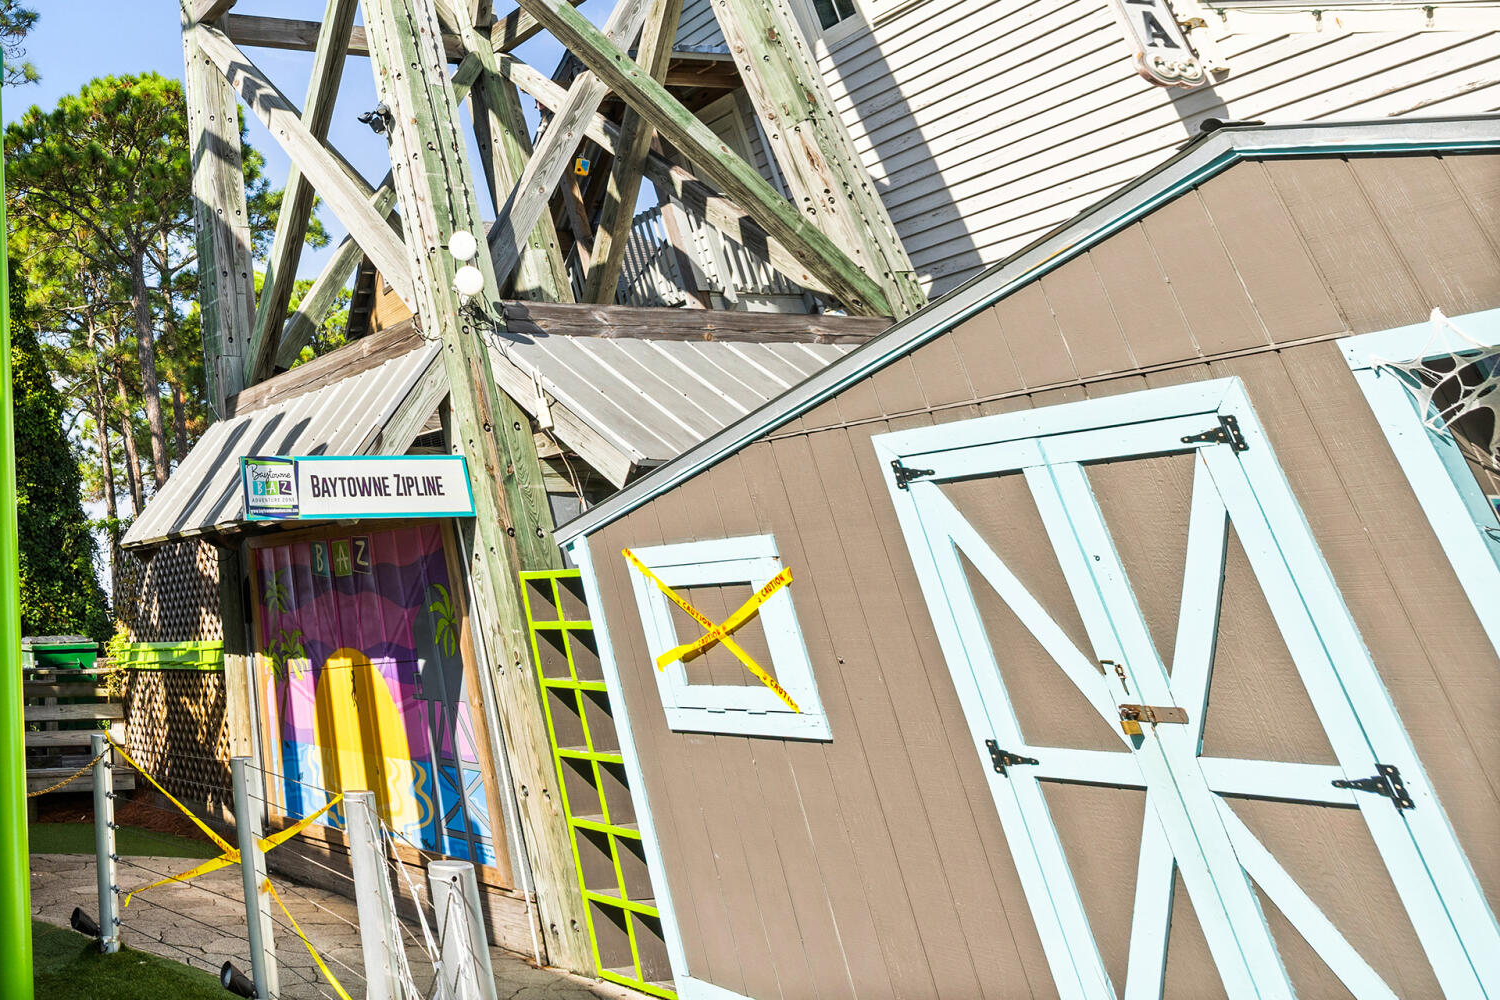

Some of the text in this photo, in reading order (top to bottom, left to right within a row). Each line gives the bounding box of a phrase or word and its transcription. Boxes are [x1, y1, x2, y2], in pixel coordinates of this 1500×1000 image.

[246, 463, 292, 484] Baytowne
[310, 473, 446, 499] BAYTOWNE ZIPLINE
[253, 480, 293, 496] BAZ
[315, 541, 368, 573] BAZ
[761, 574, 786, 598] CAUTION
[682, 602, 712, 629] CAUTION
[769, 679, 797, 707] CAUTI
